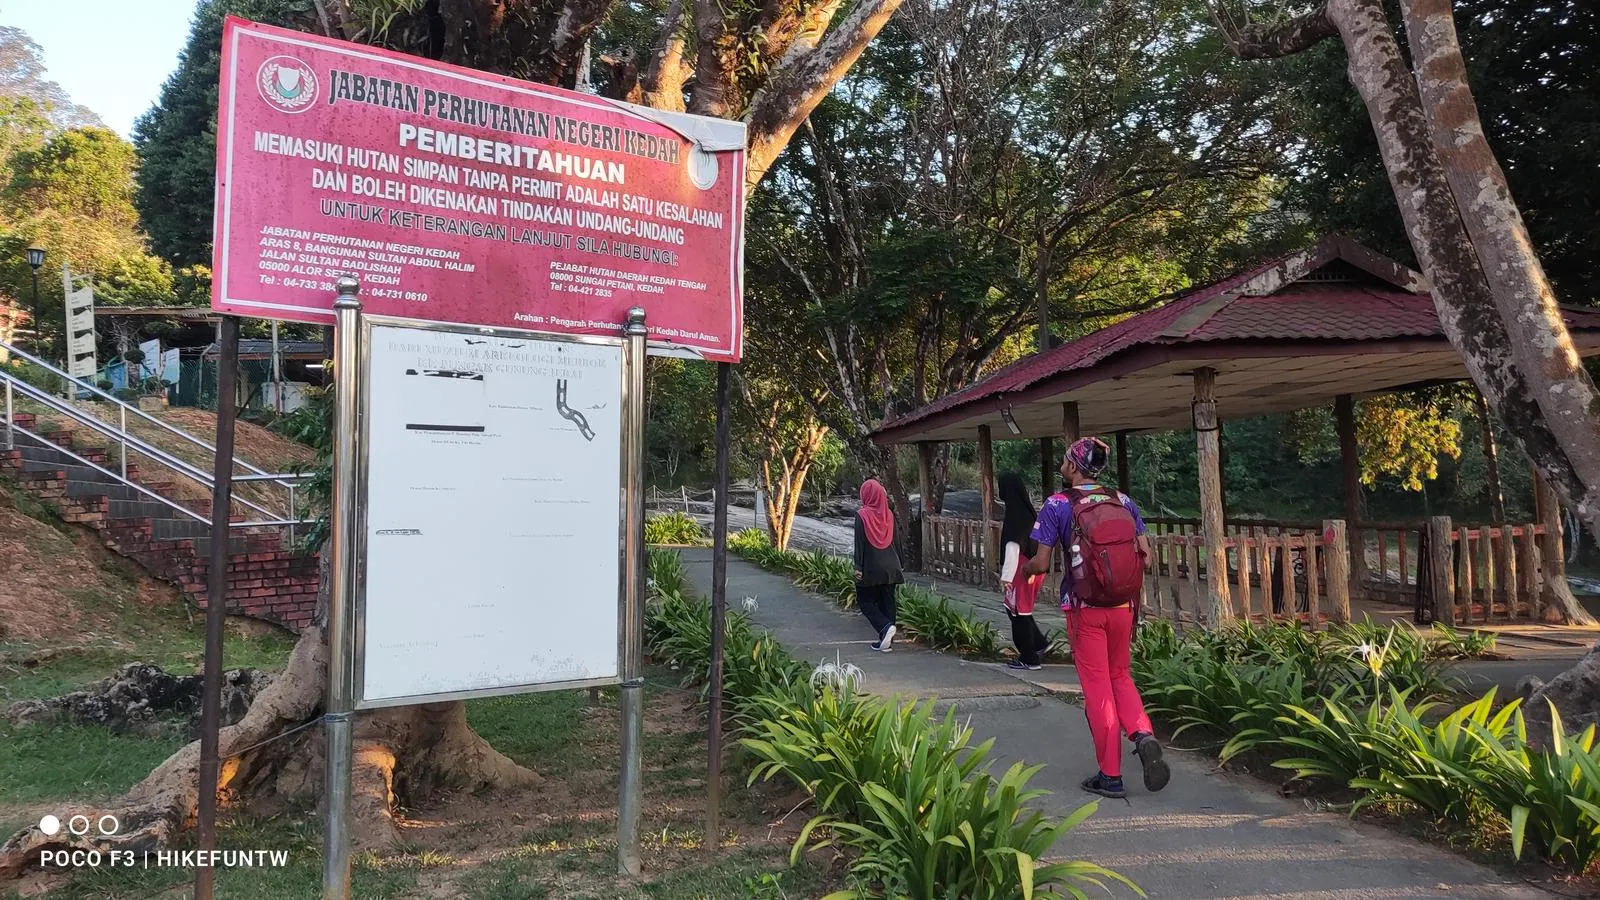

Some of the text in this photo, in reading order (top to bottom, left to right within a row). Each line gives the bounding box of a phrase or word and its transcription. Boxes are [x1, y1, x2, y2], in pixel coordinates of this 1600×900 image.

[328, 69, 680, 164] JABATAN PERHUTANAN NEGERI KEDAH
[399, 123, 625, 184] PEMBERITAHUAN
[254, 131, 723, 230] MEMASUKI HUTAN SIMPAN TANPA PERMIT ADALAH SATU KESALAHAN
[312, 168, 684, 246] DAN BOLEH DIKENAKAN TINDAKAN UNDANG-UNDANG
[260, 225, 460, 260] JABATAN PERHUTANAN NEGERI KEDAH
[320, 199, 679, 266] UNTUK KETERANGAN LANJUT SILA HUBUNGI:
[259, 237, 475, 272] ARAS 8, BANGUNAN SULTAN ABDUL HALIM
[259, 249, 402, 275] JALAN SULTAN BADLISHAH
[259, 260, 290, 272] 05000
[291, 264, 323, 276] ALOR
[364, 273, 400, 286] KEDAH
[259, 274, 274, 285] Tel
[283, 277, 317, 290] 04-733
[550, 261, 707, 290] PEJABAT HUTAN DAERAH KEDAH TENGAH
[550, 272, 665, 294] 08000 SUNGAI PETANI, KEDAH.
[371, 288, 402, 299] 04-731
[405, 291, 428, 302] 0610
[551, 282, 562, 292] Tel
[568, 285, 593, 295] 04-421
[594, 289, 613, 298] 2835
[514, 312, 544, 323] Arahan
[550, 316, 587, 329] Pengarah
[656, 324, 679, 336] Kedah
[680, 329, 698, 340] Darul
[699, 332, 721, 343] Aman.
